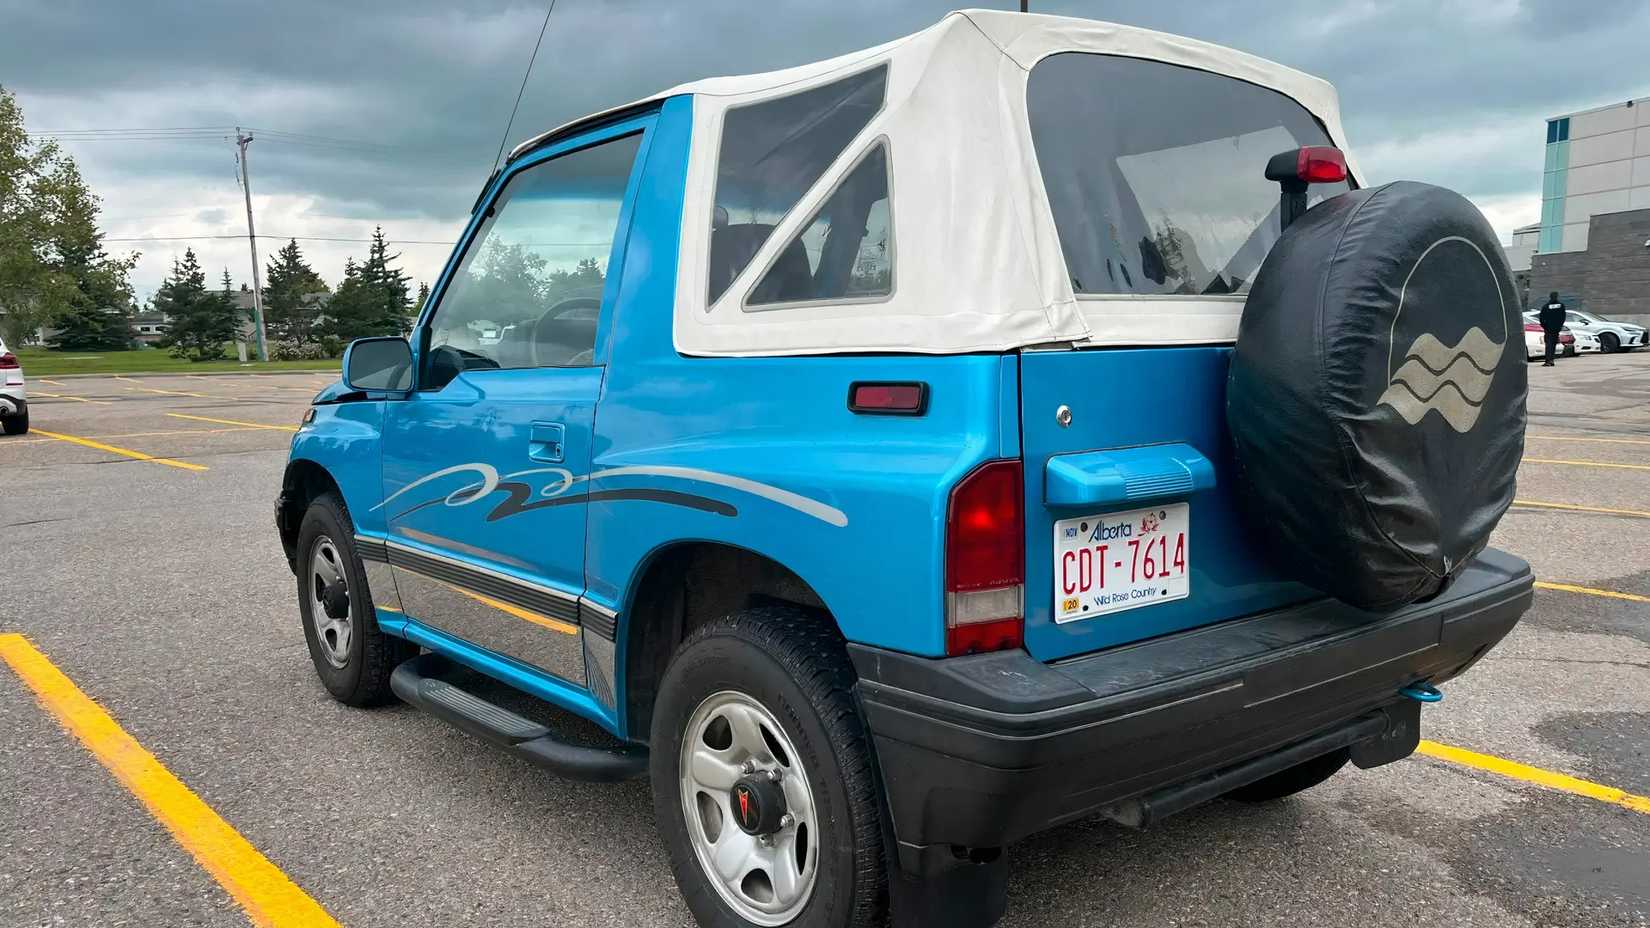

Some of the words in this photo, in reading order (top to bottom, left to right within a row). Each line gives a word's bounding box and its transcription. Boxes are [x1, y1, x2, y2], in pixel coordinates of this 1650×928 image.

[1088, 520, 1132, 543] Alberta
[1062, 532, 1185, 595] CDT-7614
[1067, 599, 1078, 610] 20
[1112, 592, 1129, 603] Rose
[1131, 586, 1157, 599] Country
